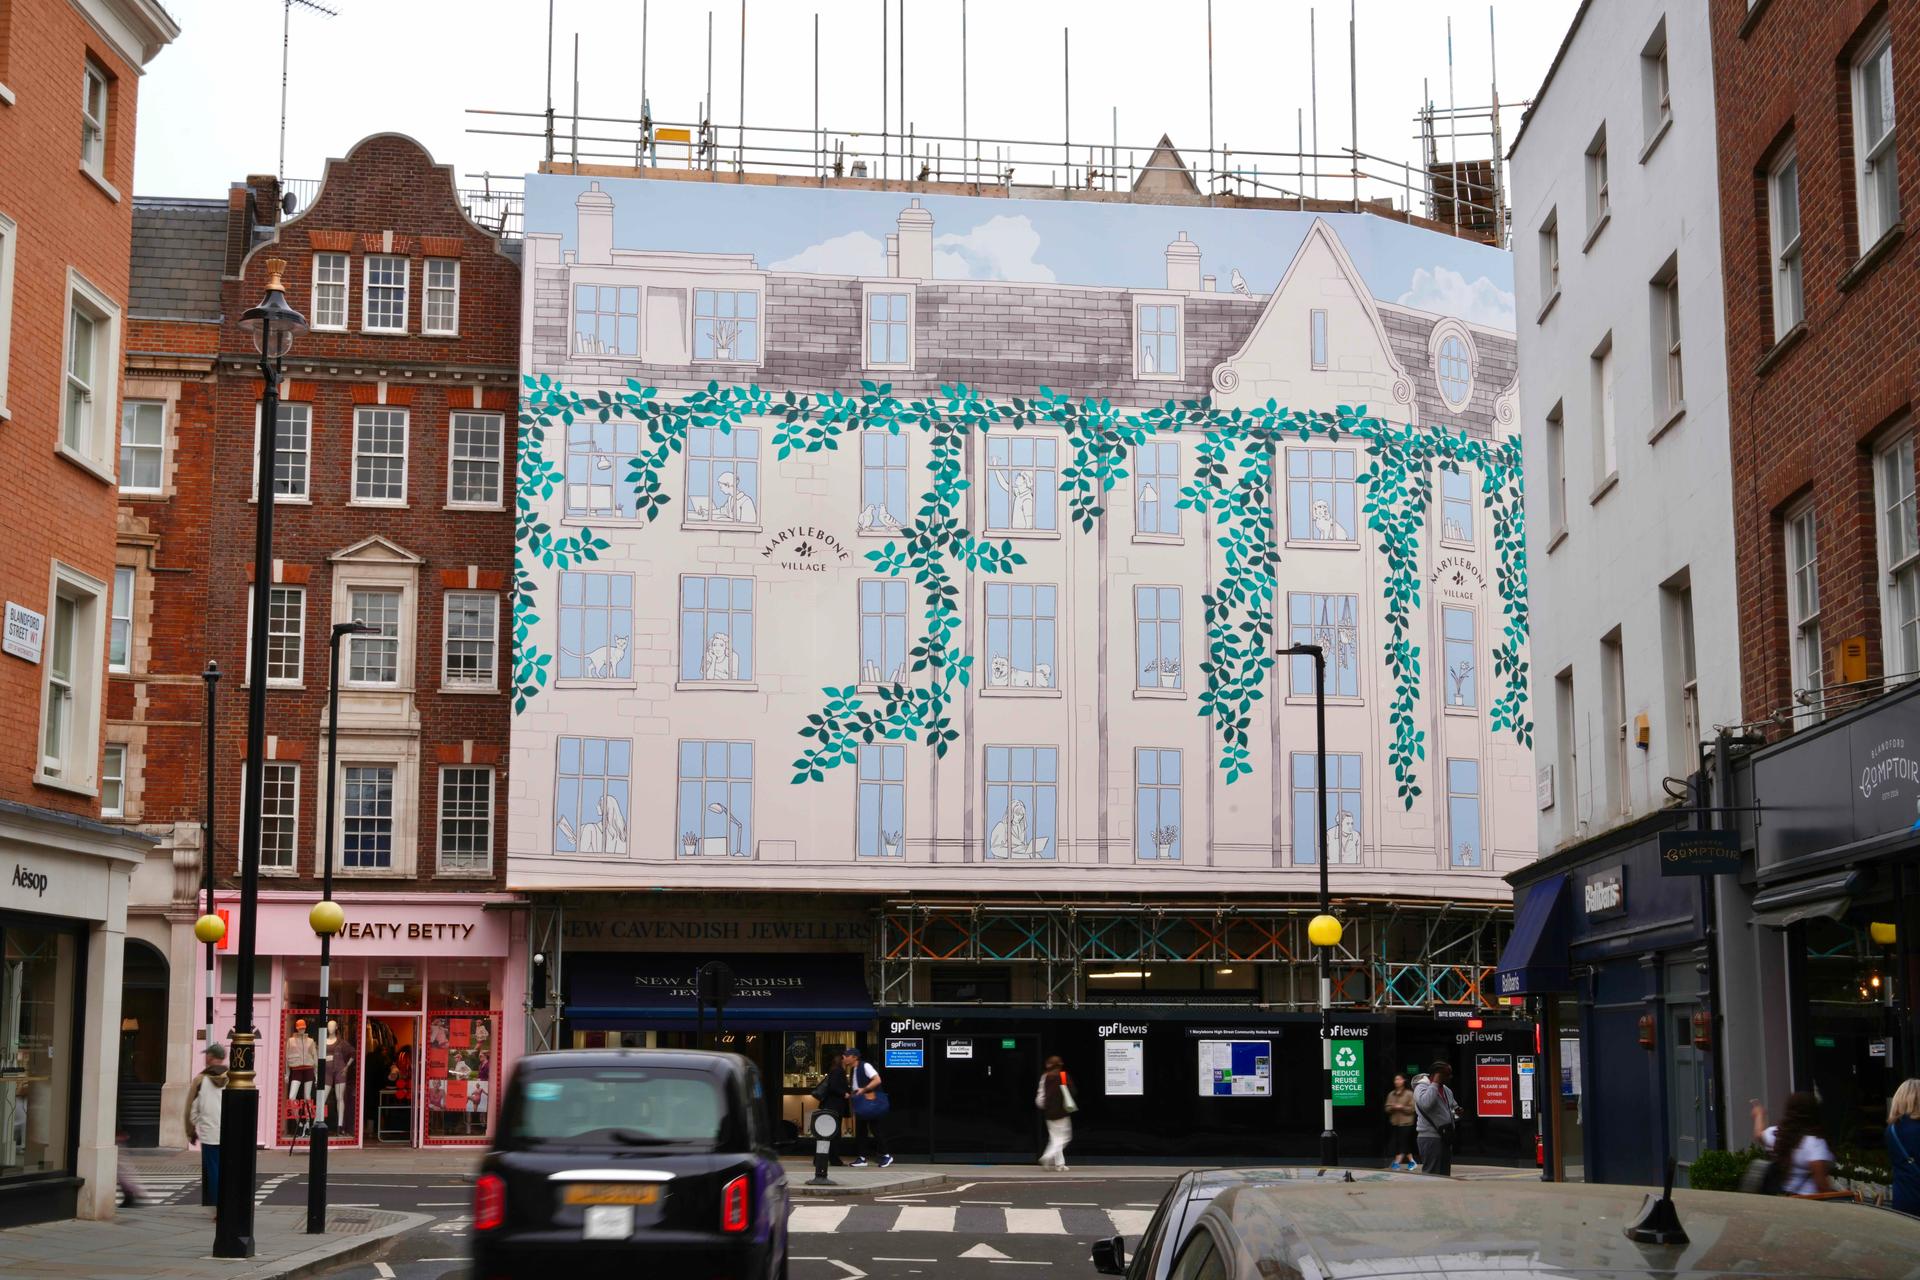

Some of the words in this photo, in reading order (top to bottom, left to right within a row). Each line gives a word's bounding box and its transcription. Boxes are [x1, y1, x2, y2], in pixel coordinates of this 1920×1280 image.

[762, 526, 849, 561] MARYLEBONE
[781, 562, 827, 572] VILLAGE
[1431, 557, 1488, 591] MARYLEBONE
[1443, 588, 1474, 600] VILLAGE
[10, 607, 40, 631] BLANDFORD
[9, 622, 29, 641] STREET
[1871, 738, 1905, 759] BLANDFORD
[1859, 757, 1920, 798] COMPTOIR
[316, 922, 402, 939] WEATY
[408, 923, 475, 939] BETTY
[611, 920, 739, 938] CAVENDISH
[748, 920, 872, 939] JEWELLERS
[635, 976, 680, 985] NEW
[687, 976, 803, 986] CNDISH
[890, 1019, 941, 1033] gpflewis
[1098, 1022, 1148, 1037] gpflewis
